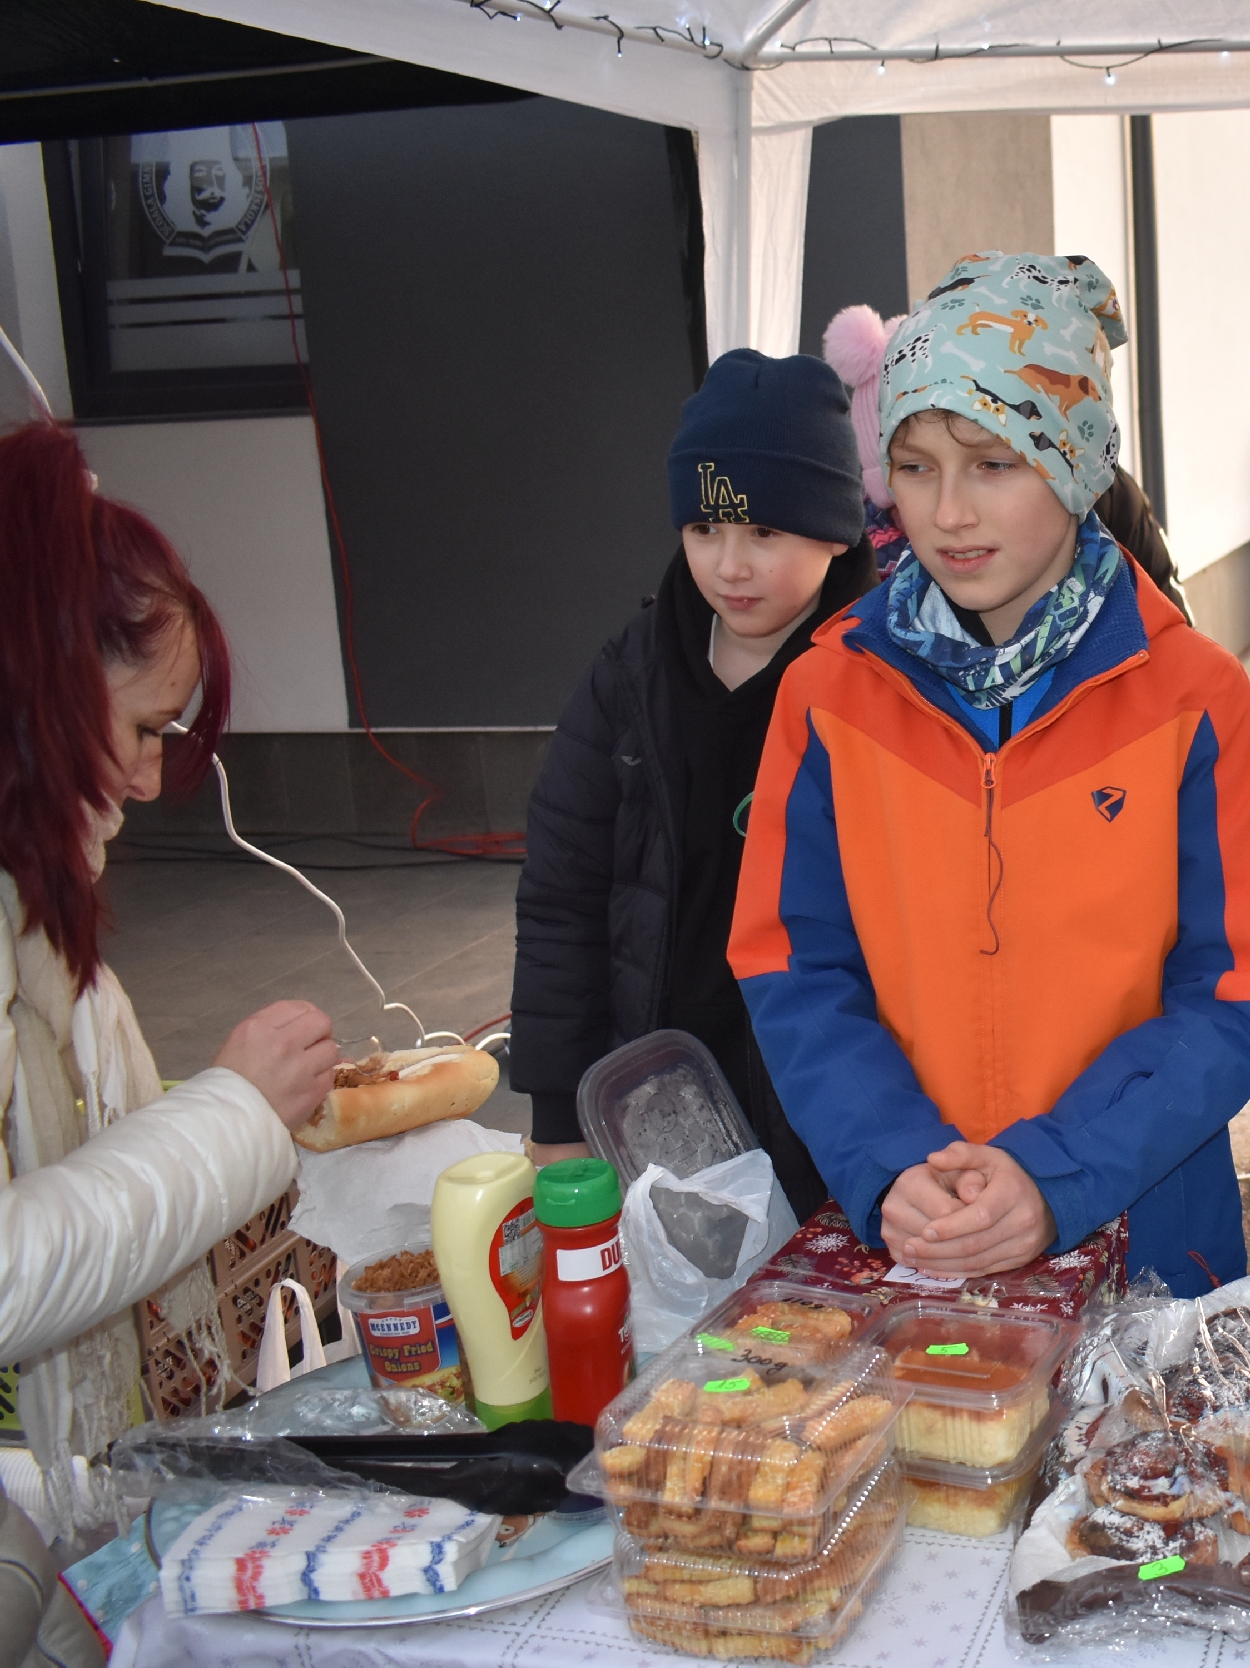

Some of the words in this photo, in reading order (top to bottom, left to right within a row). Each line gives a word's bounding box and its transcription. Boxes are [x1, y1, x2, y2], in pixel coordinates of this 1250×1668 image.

[698, 462, 750, 523] LA
[369, 1343, 400, 1359] Crispy
[403, 1341, 434, 1356] Fried
[384, 1361, 420, 1373] Onions
[1151, 1562, 1169, 1576] 3
